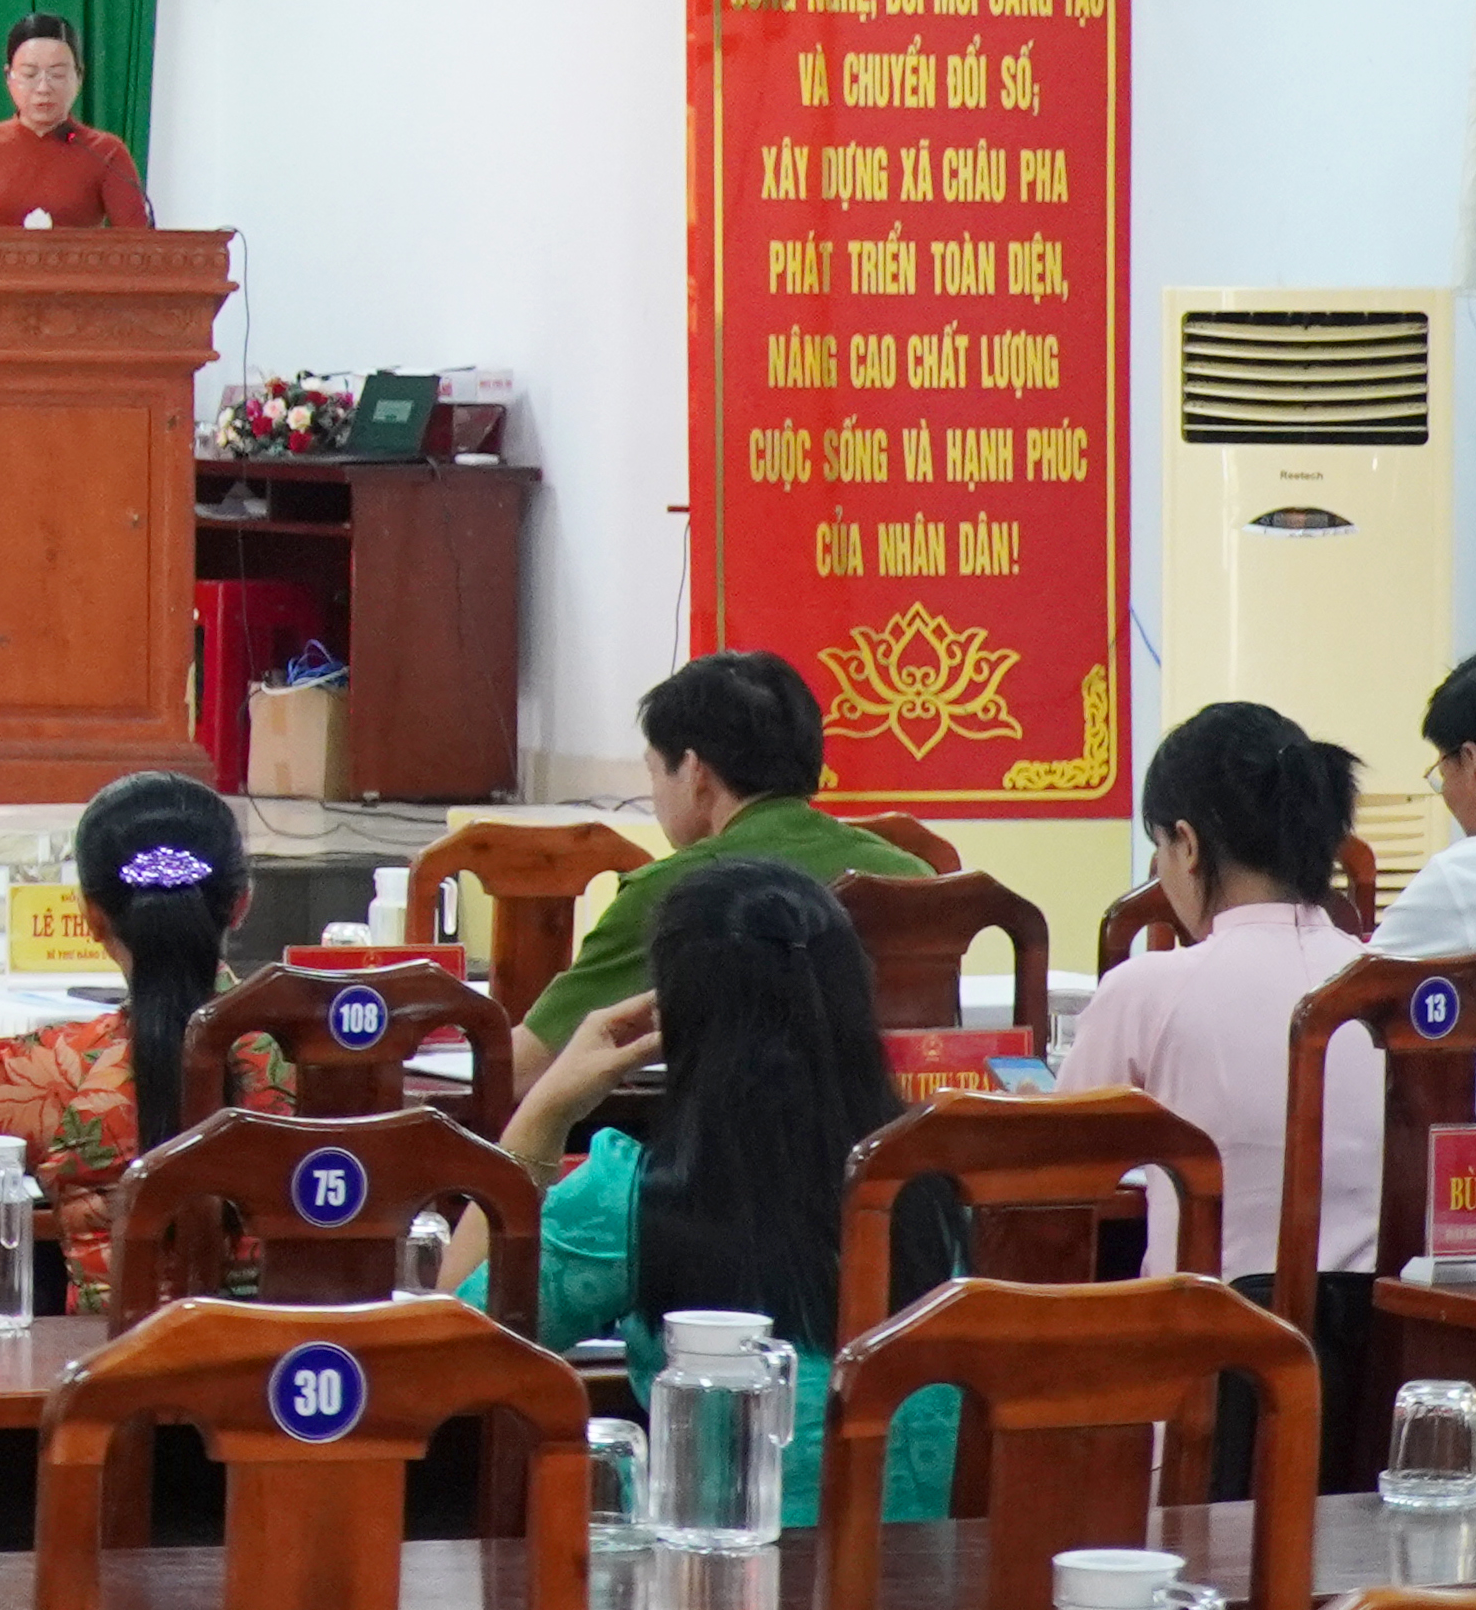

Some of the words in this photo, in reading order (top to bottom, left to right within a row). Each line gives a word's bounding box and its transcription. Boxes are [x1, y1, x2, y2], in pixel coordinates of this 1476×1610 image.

[798, 43, 829, 109] VÀ
[843, 34, 937, 110] CHUYỂN
[947, 34, 987, 112] ĐỔI
[761, 136, 808, 201] XÂY
[822, 140, 888, 211] DỰNG
[900, 138, 933, 202] XÃ
[942, 140, 1007, 202] CHÂU
[1020, 148, 1068, 204] PHA
[769, 230, 832, 295] PHÁT
[847, 220, 916, 296] TRIỂN
[931, 232, 995, 297] TOÀN
[1009, 235, 1069, 306] DIỆN,
[768, 324, 837, 389] NÂNG
[850, 336, 897, 390] CAO
[907, 320, 969, 391] CHẤT
[981, 330, 1059, 399] LƯỢNG
[750, 419, 812, 492] CUỘC
[823, 412, 888, 482] SỐNG
[902, 419, 932, 484] VÀ
[946, 427, 1013, 492] HẠNH
[1027, 419, 1088, 484] PHÚC
[816, 504, 864, 577] CỦA
[878, 513, 946, 578] NHÂN
[959, 512, 1020, 578] DÂN!
[32, 907, 55, 937] LÊ
[340, 1003, 378, 1033] 108
[1425, 994, 1447, 1022] 13
[314, 1169, 347, 1207] 75
[295, 1369, 341, 1417] 30
